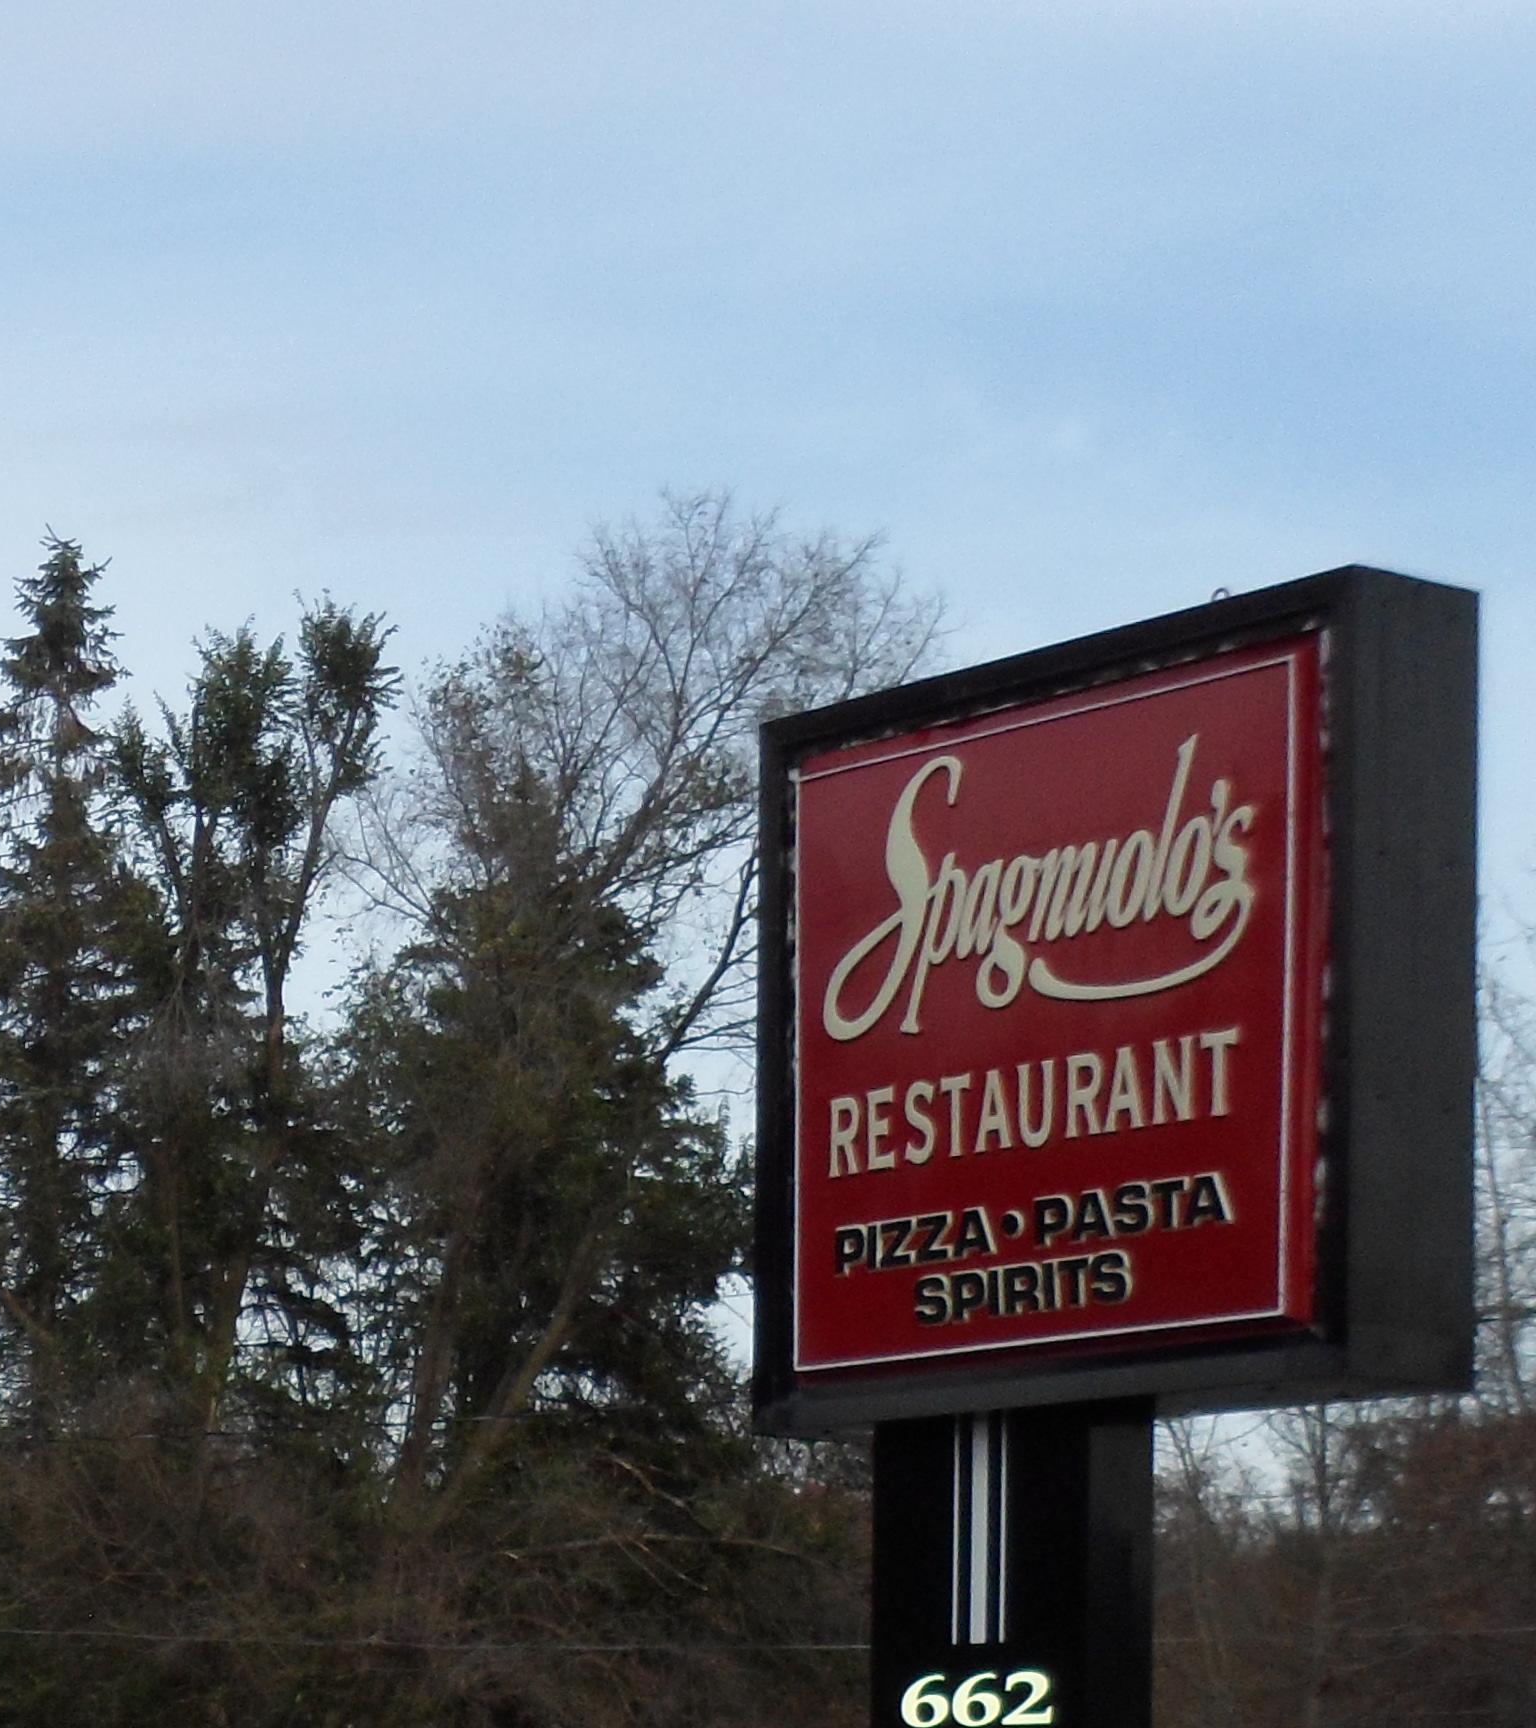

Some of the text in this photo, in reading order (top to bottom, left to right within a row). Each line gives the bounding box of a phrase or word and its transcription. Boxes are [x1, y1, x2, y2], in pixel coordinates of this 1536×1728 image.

[823, 733, 1256, 1042] Spagnuolo's
[828, 1026, 1240, 1178] RESTAURANT
[834, 1172, 1235, 1277] PIZZA PASTA
[913, 1249, 1134, 1326] SPIRITS
[900, 1671, 1054, 1728] 662
